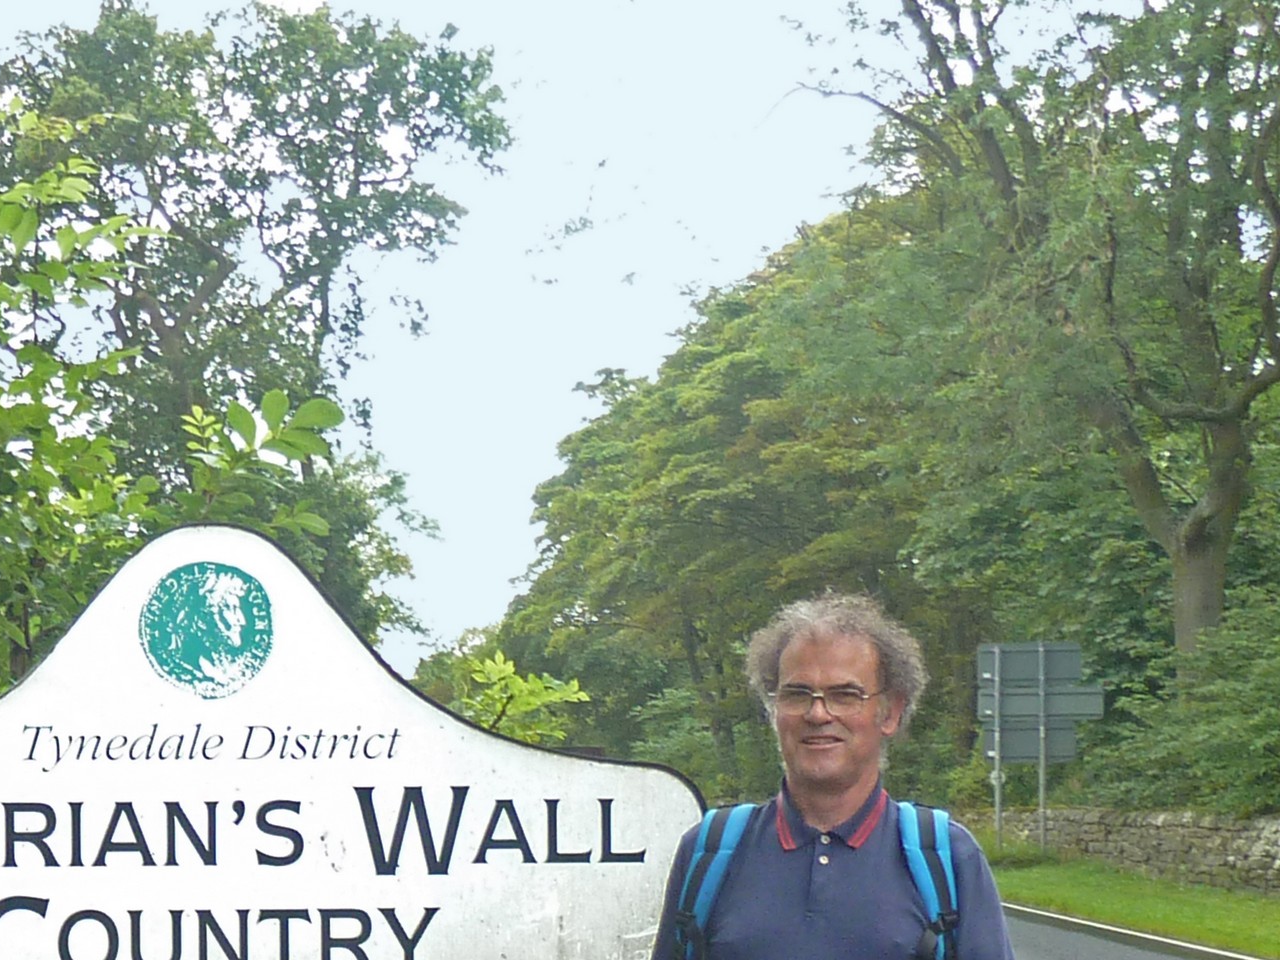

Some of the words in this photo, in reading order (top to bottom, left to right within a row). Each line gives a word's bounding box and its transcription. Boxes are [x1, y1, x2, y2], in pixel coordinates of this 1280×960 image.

[22, 723, 224, 773] Tynedale
[237, 724, 403, 761] District
[352, 785, 647, 876] WALL
